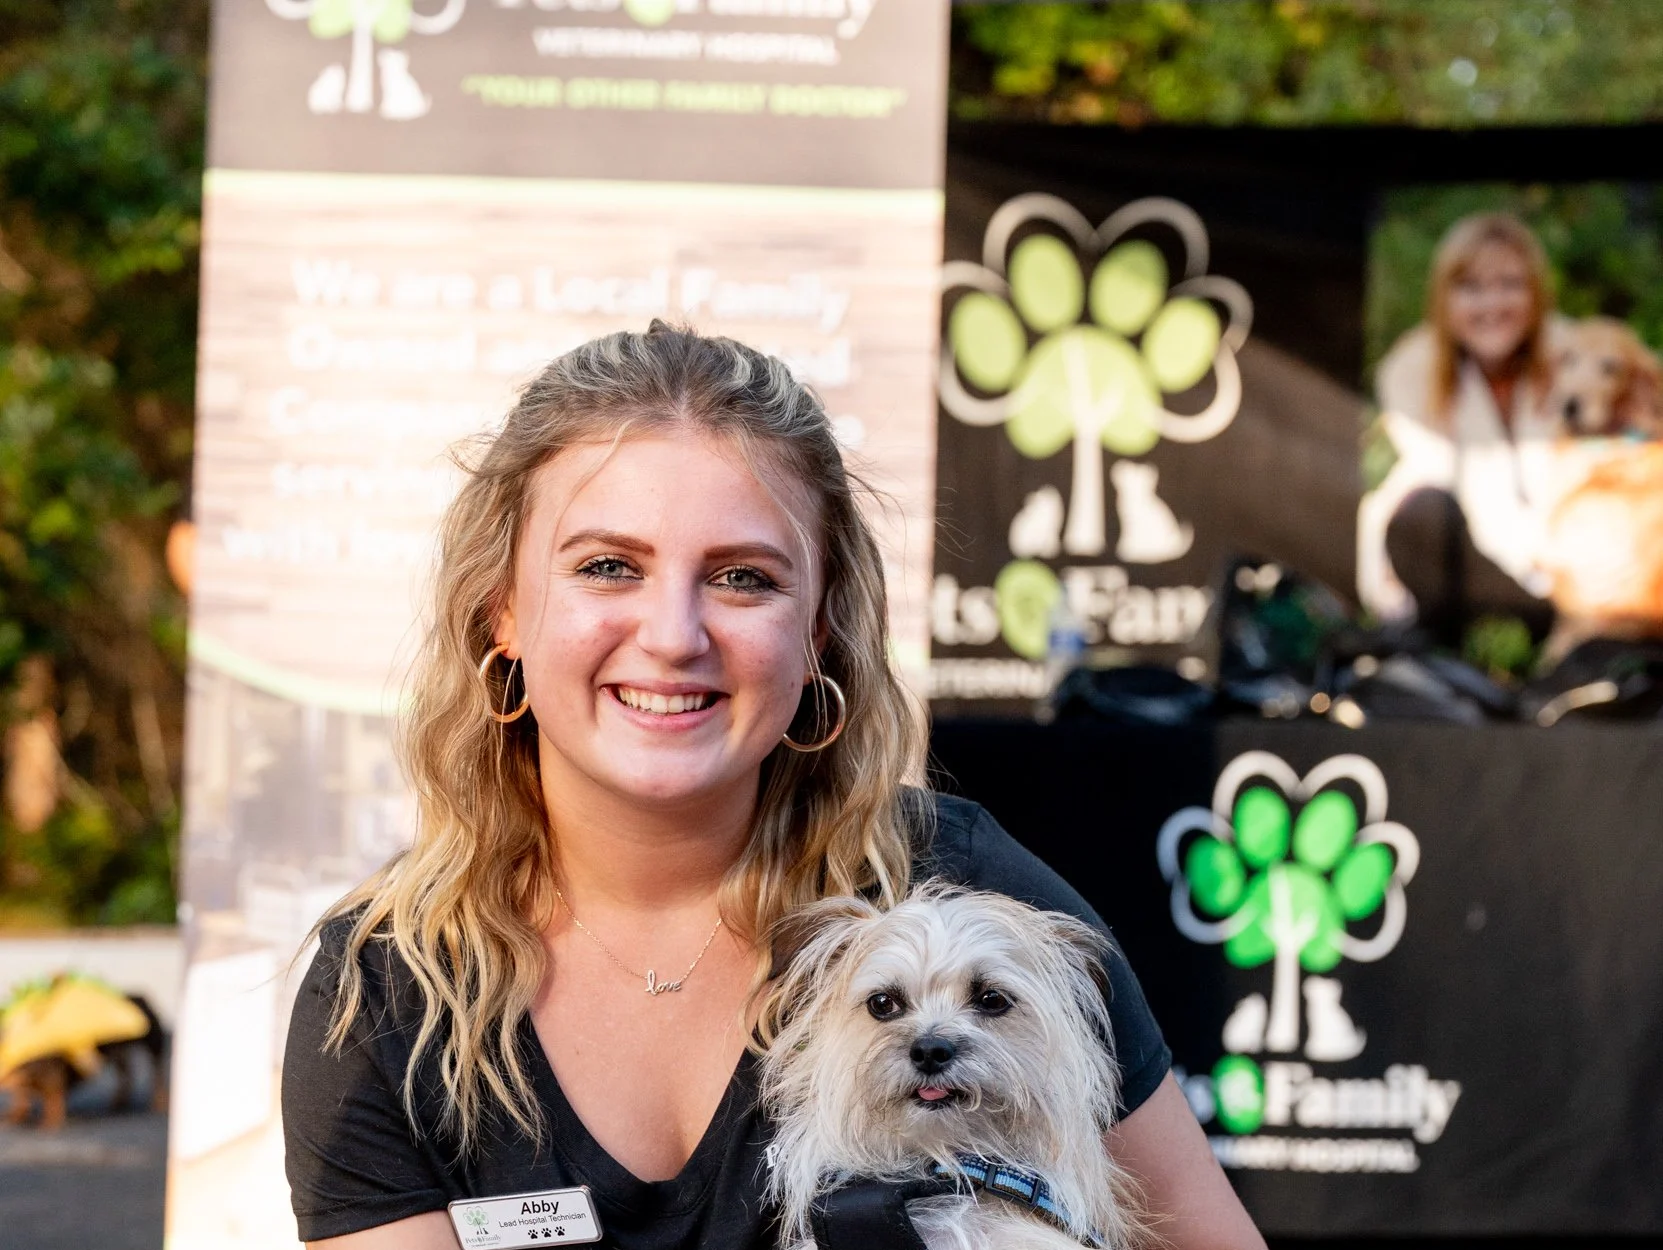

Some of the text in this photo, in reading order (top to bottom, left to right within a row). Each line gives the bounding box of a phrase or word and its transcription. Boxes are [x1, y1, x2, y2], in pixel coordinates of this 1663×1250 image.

[292, 260, 379, 307] We
[645, 969, 682, 996] love
[1263, 1061, 1463, 1144] Family
[498, 1212, 586, 1228] Lead Hospital Technician
[521, 1200, 559, 1215] Abby
